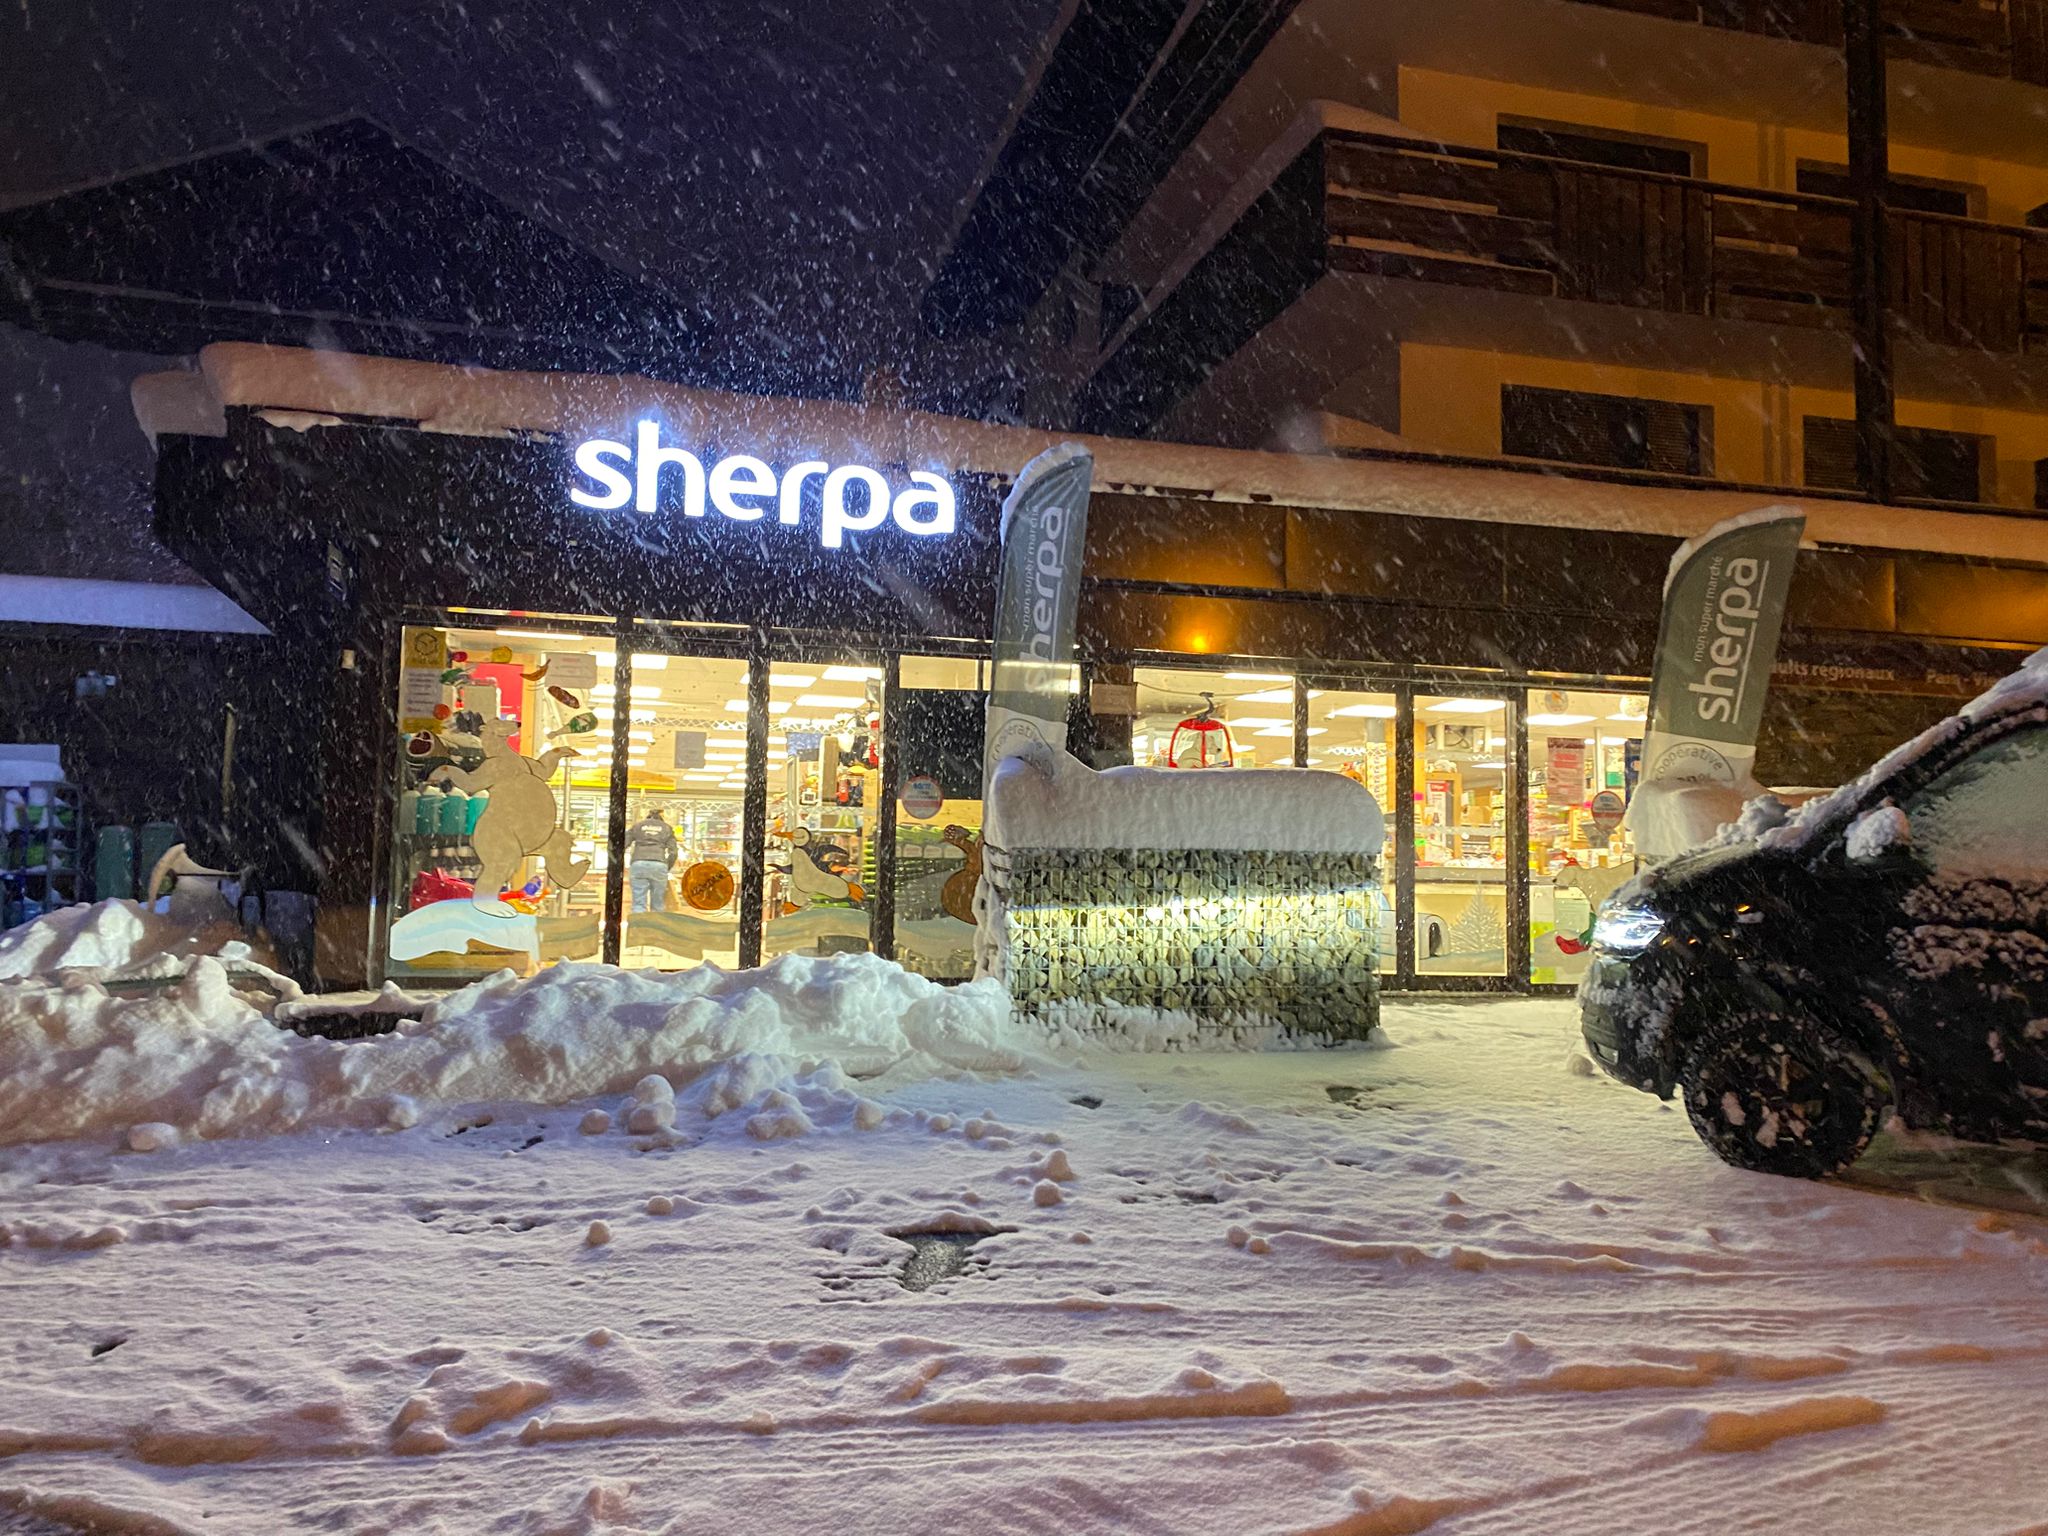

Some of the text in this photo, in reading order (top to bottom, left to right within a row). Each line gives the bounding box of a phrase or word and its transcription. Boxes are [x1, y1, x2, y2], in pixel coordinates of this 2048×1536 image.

[571, 420, 956, 548] sherpa
[1020, 505, 1063, 693] sherpa
[1024, 557, 1034, 594] super
[1694, 556, 1723, 662] mon super marché
[1688, 557, 1760, 723] sherpa
